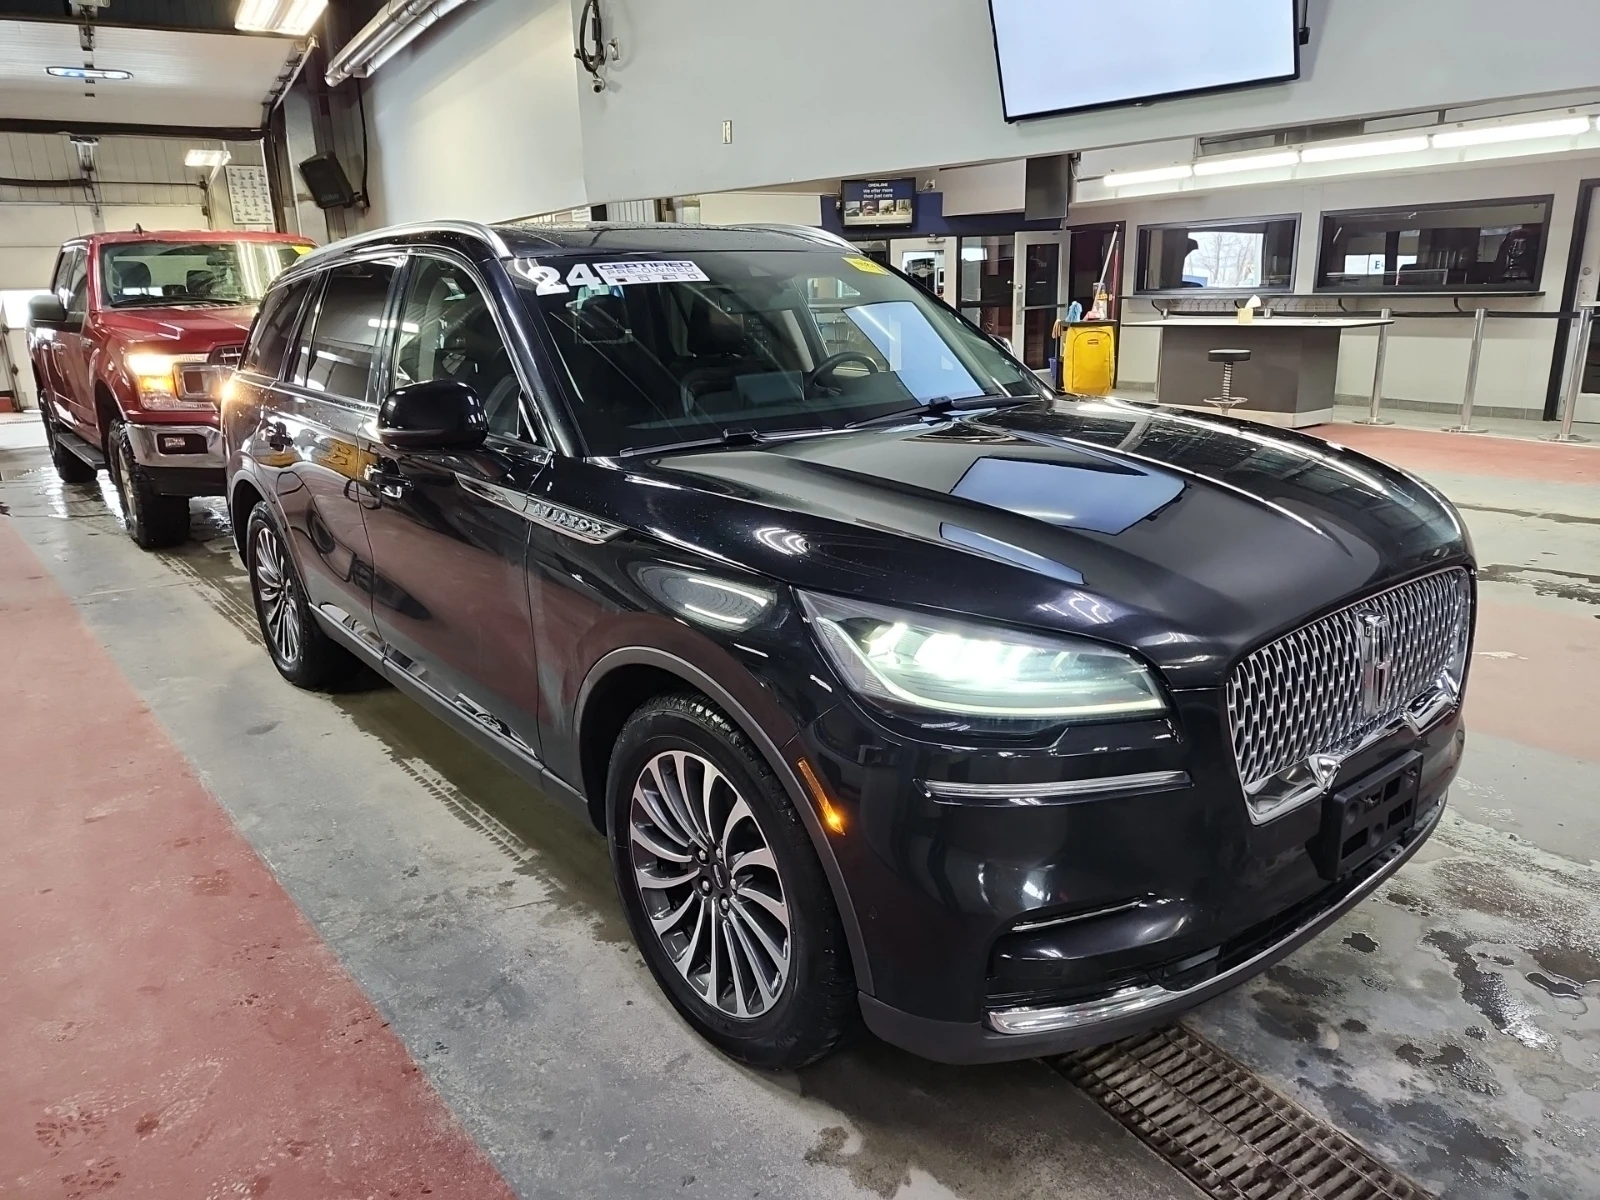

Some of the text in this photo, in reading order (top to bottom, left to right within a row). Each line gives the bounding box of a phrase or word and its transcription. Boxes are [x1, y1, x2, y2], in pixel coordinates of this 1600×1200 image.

[599, 262, 693, 270] CERTIFIED
[606, 266, 695, 275] PRE-OWNED
[527, 263, 603, 296] 24
[533, 503, 606, 535] AVIATOR
